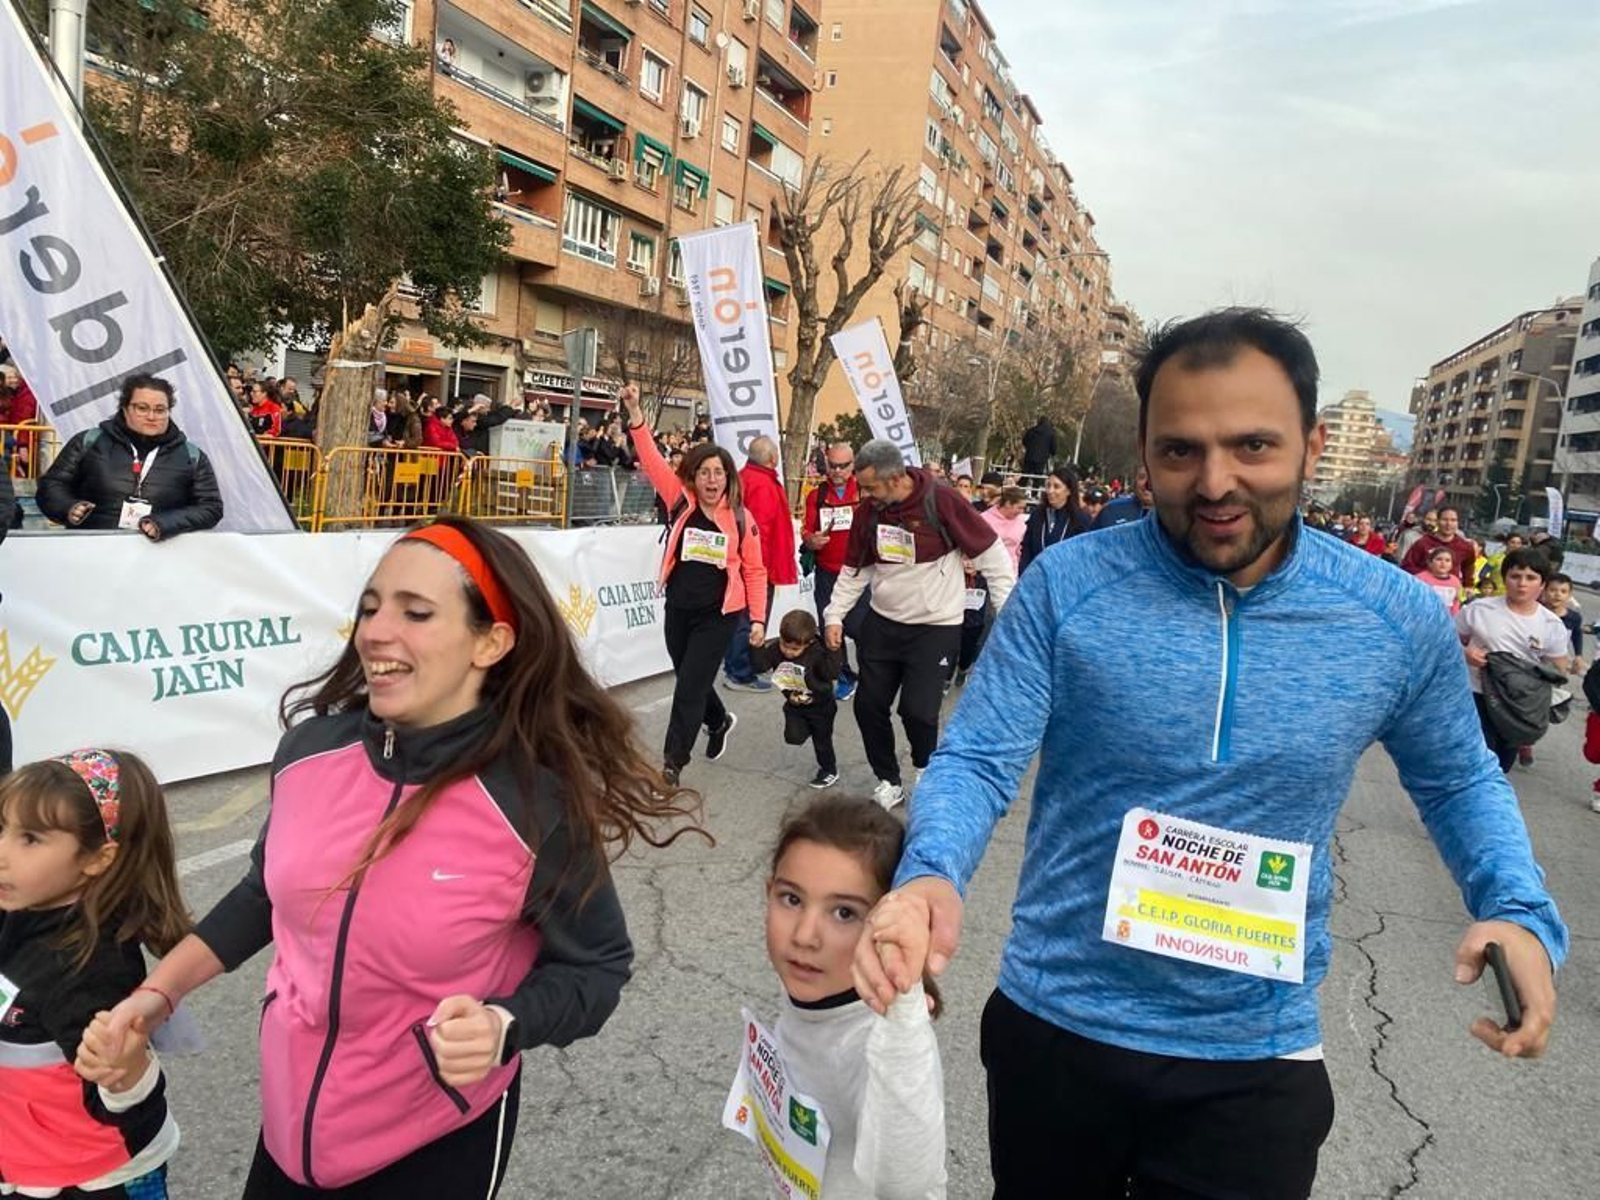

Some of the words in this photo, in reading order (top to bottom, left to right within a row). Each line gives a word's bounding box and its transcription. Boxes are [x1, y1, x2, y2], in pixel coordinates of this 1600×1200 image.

[532, 372, 576, 388] CAFETERI
[598, 584, 631, 607] CAJA
[625, 603, 656, 629] JAÉN
[71, 628, 173, 666] CAJA
[179, 616, 302, 656] RURAL
[152, 652, 244, 701] JAÉN
[1162, 835, 1222, 860] NOCHE
[1222, 848, 1246, 866] DE
[1166, 825, 1206, 843] CARRERA
[1209, 833, 1249, 851] ESCOLAR
[1136, 845, 1175, 867] SAN
[1177, 856, 1242, 883] ANTÓN
[1138, 904, 1180, 923] C.E.I.P.
[1184, 915, 1232, 936] GLORIA
[1237, 927, 1296, 950] FUERTES
[1155, 932, 1249, 967] INNOVASUR
